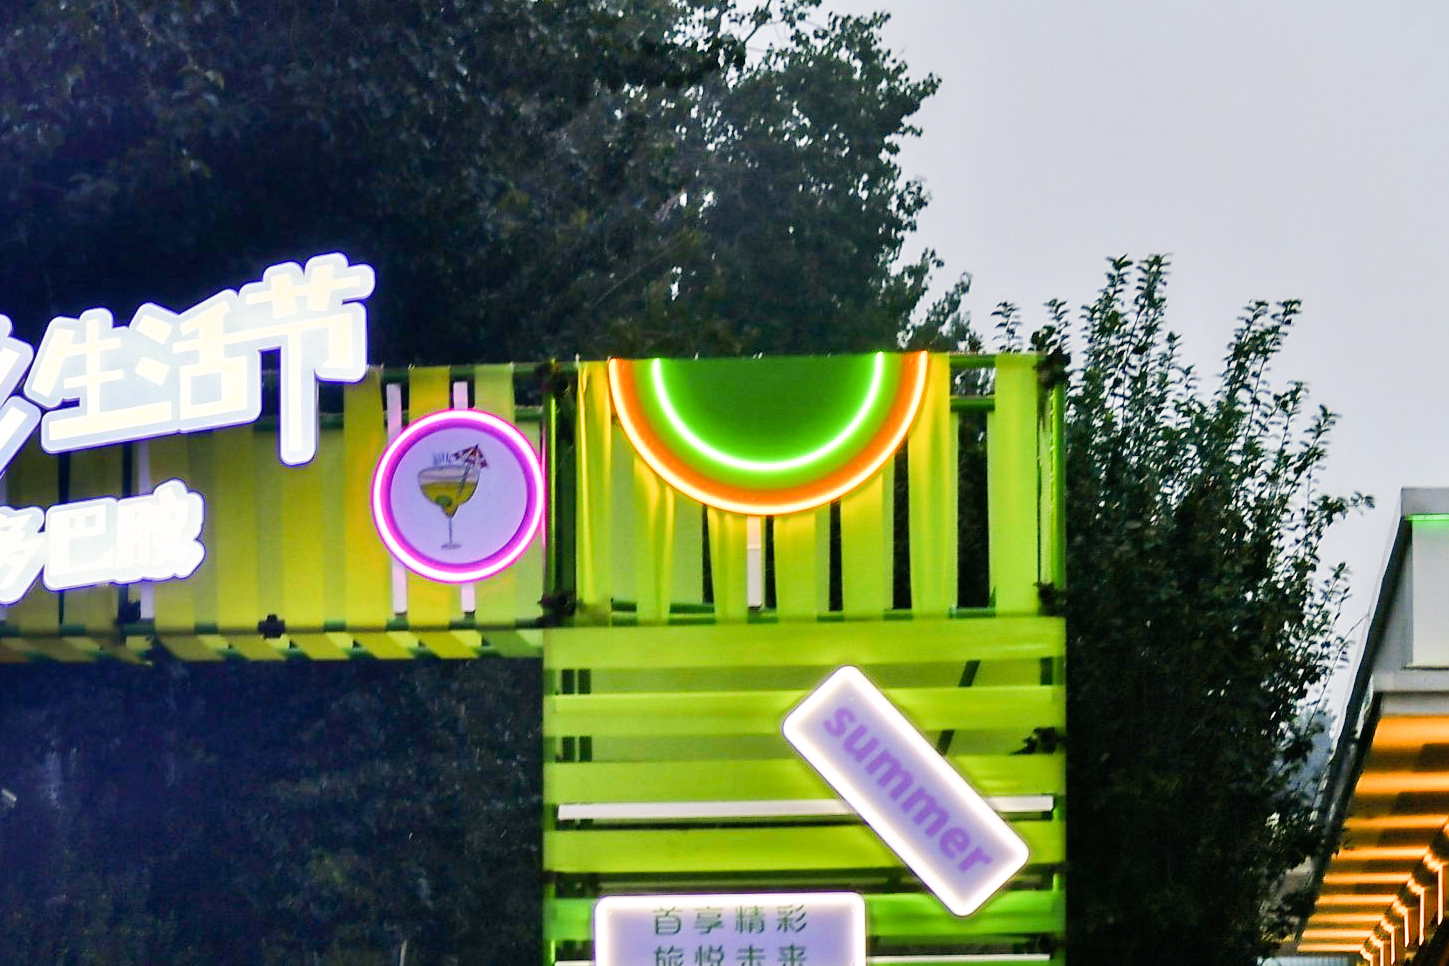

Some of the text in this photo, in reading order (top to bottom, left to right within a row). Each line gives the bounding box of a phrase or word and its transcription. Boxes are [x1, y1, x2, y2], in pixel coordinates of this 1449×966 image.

[823, 706, 993, 873] summer
[653, 904, 808, 935] 首享精彩
